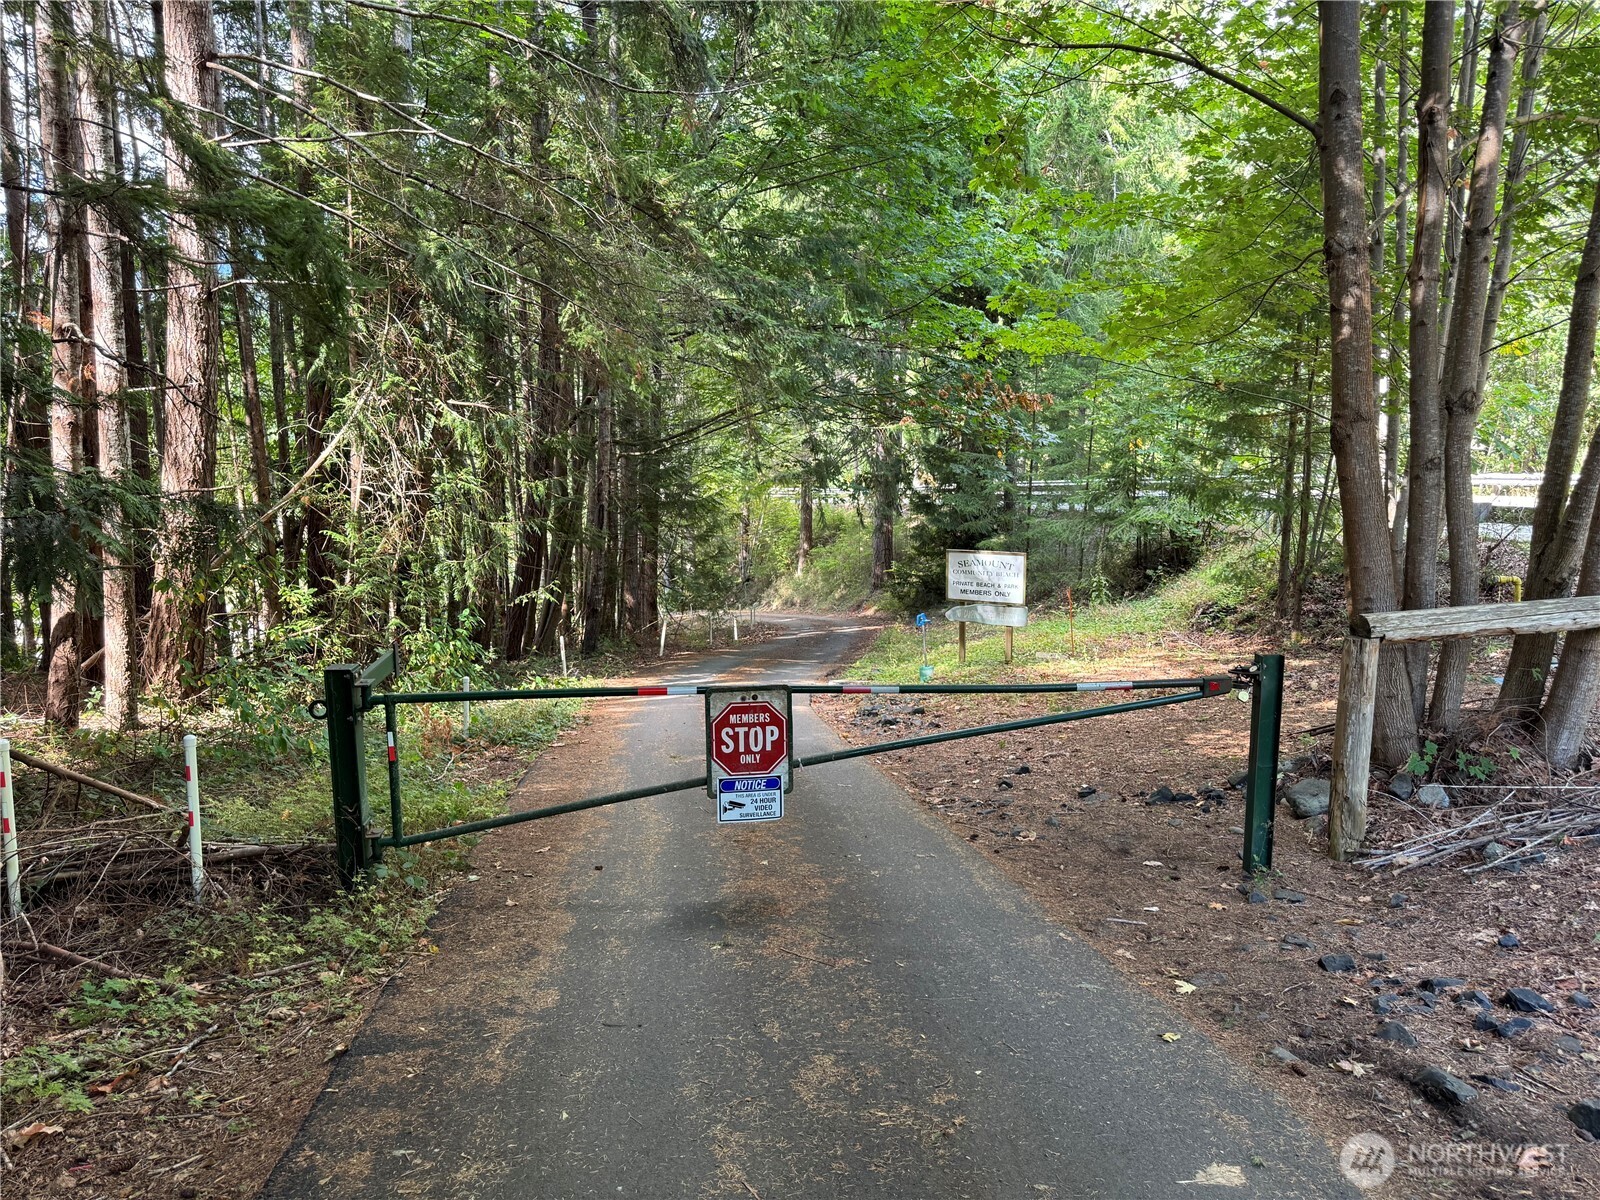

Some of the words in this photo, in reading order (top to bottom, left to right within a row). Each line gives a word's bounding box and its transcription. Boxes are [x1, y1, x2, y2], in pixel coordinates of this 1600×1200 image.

[957, 559, 1014, 570] SEAMOUNT
[995, 570, 1019, 578] BEACH
[729, 713, 770, 724] MEMBERS
[721, 725, 779, 753] STOP
[740, 754, 760, 764] ONLY
[734, 779, 767, 790] NOTICE
